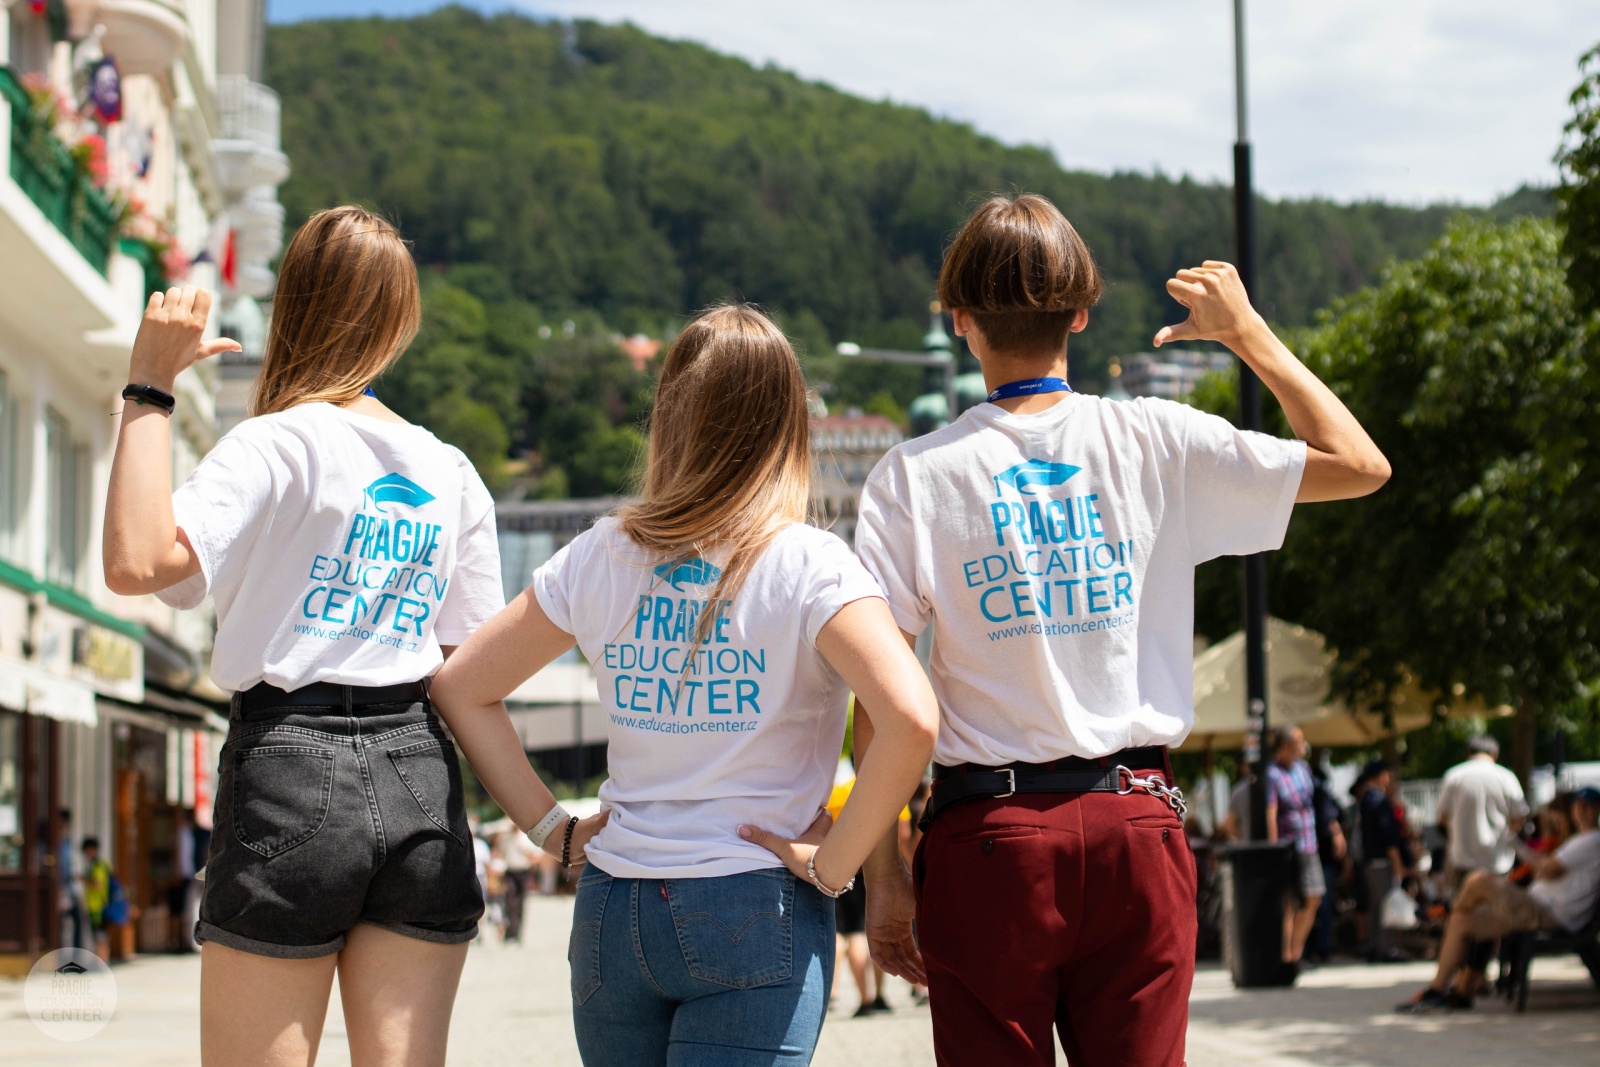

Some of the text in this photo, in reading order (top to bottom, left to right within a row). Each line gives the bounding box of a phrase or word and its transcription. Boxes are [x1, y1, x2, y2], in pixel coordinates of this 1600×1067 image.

[343, 513, 442, 567] PRAGUE
[990, 494, 1104, 547] PRAGUE
[309, 554, 448, 601] EDUCATION
[963, 539, 1133, 588] EDUCATION
[302, 586, 431, 637] CENTER
[979, 571, 1134, 623] CENTER
[987, 612, 1134, 641] www.edationcenter.cz
[604, 643, 766, 675] EDUCATION
[614, 674, 761, 717] CENTER
[610, 713, 758, 734] www.educationcenter.cz
